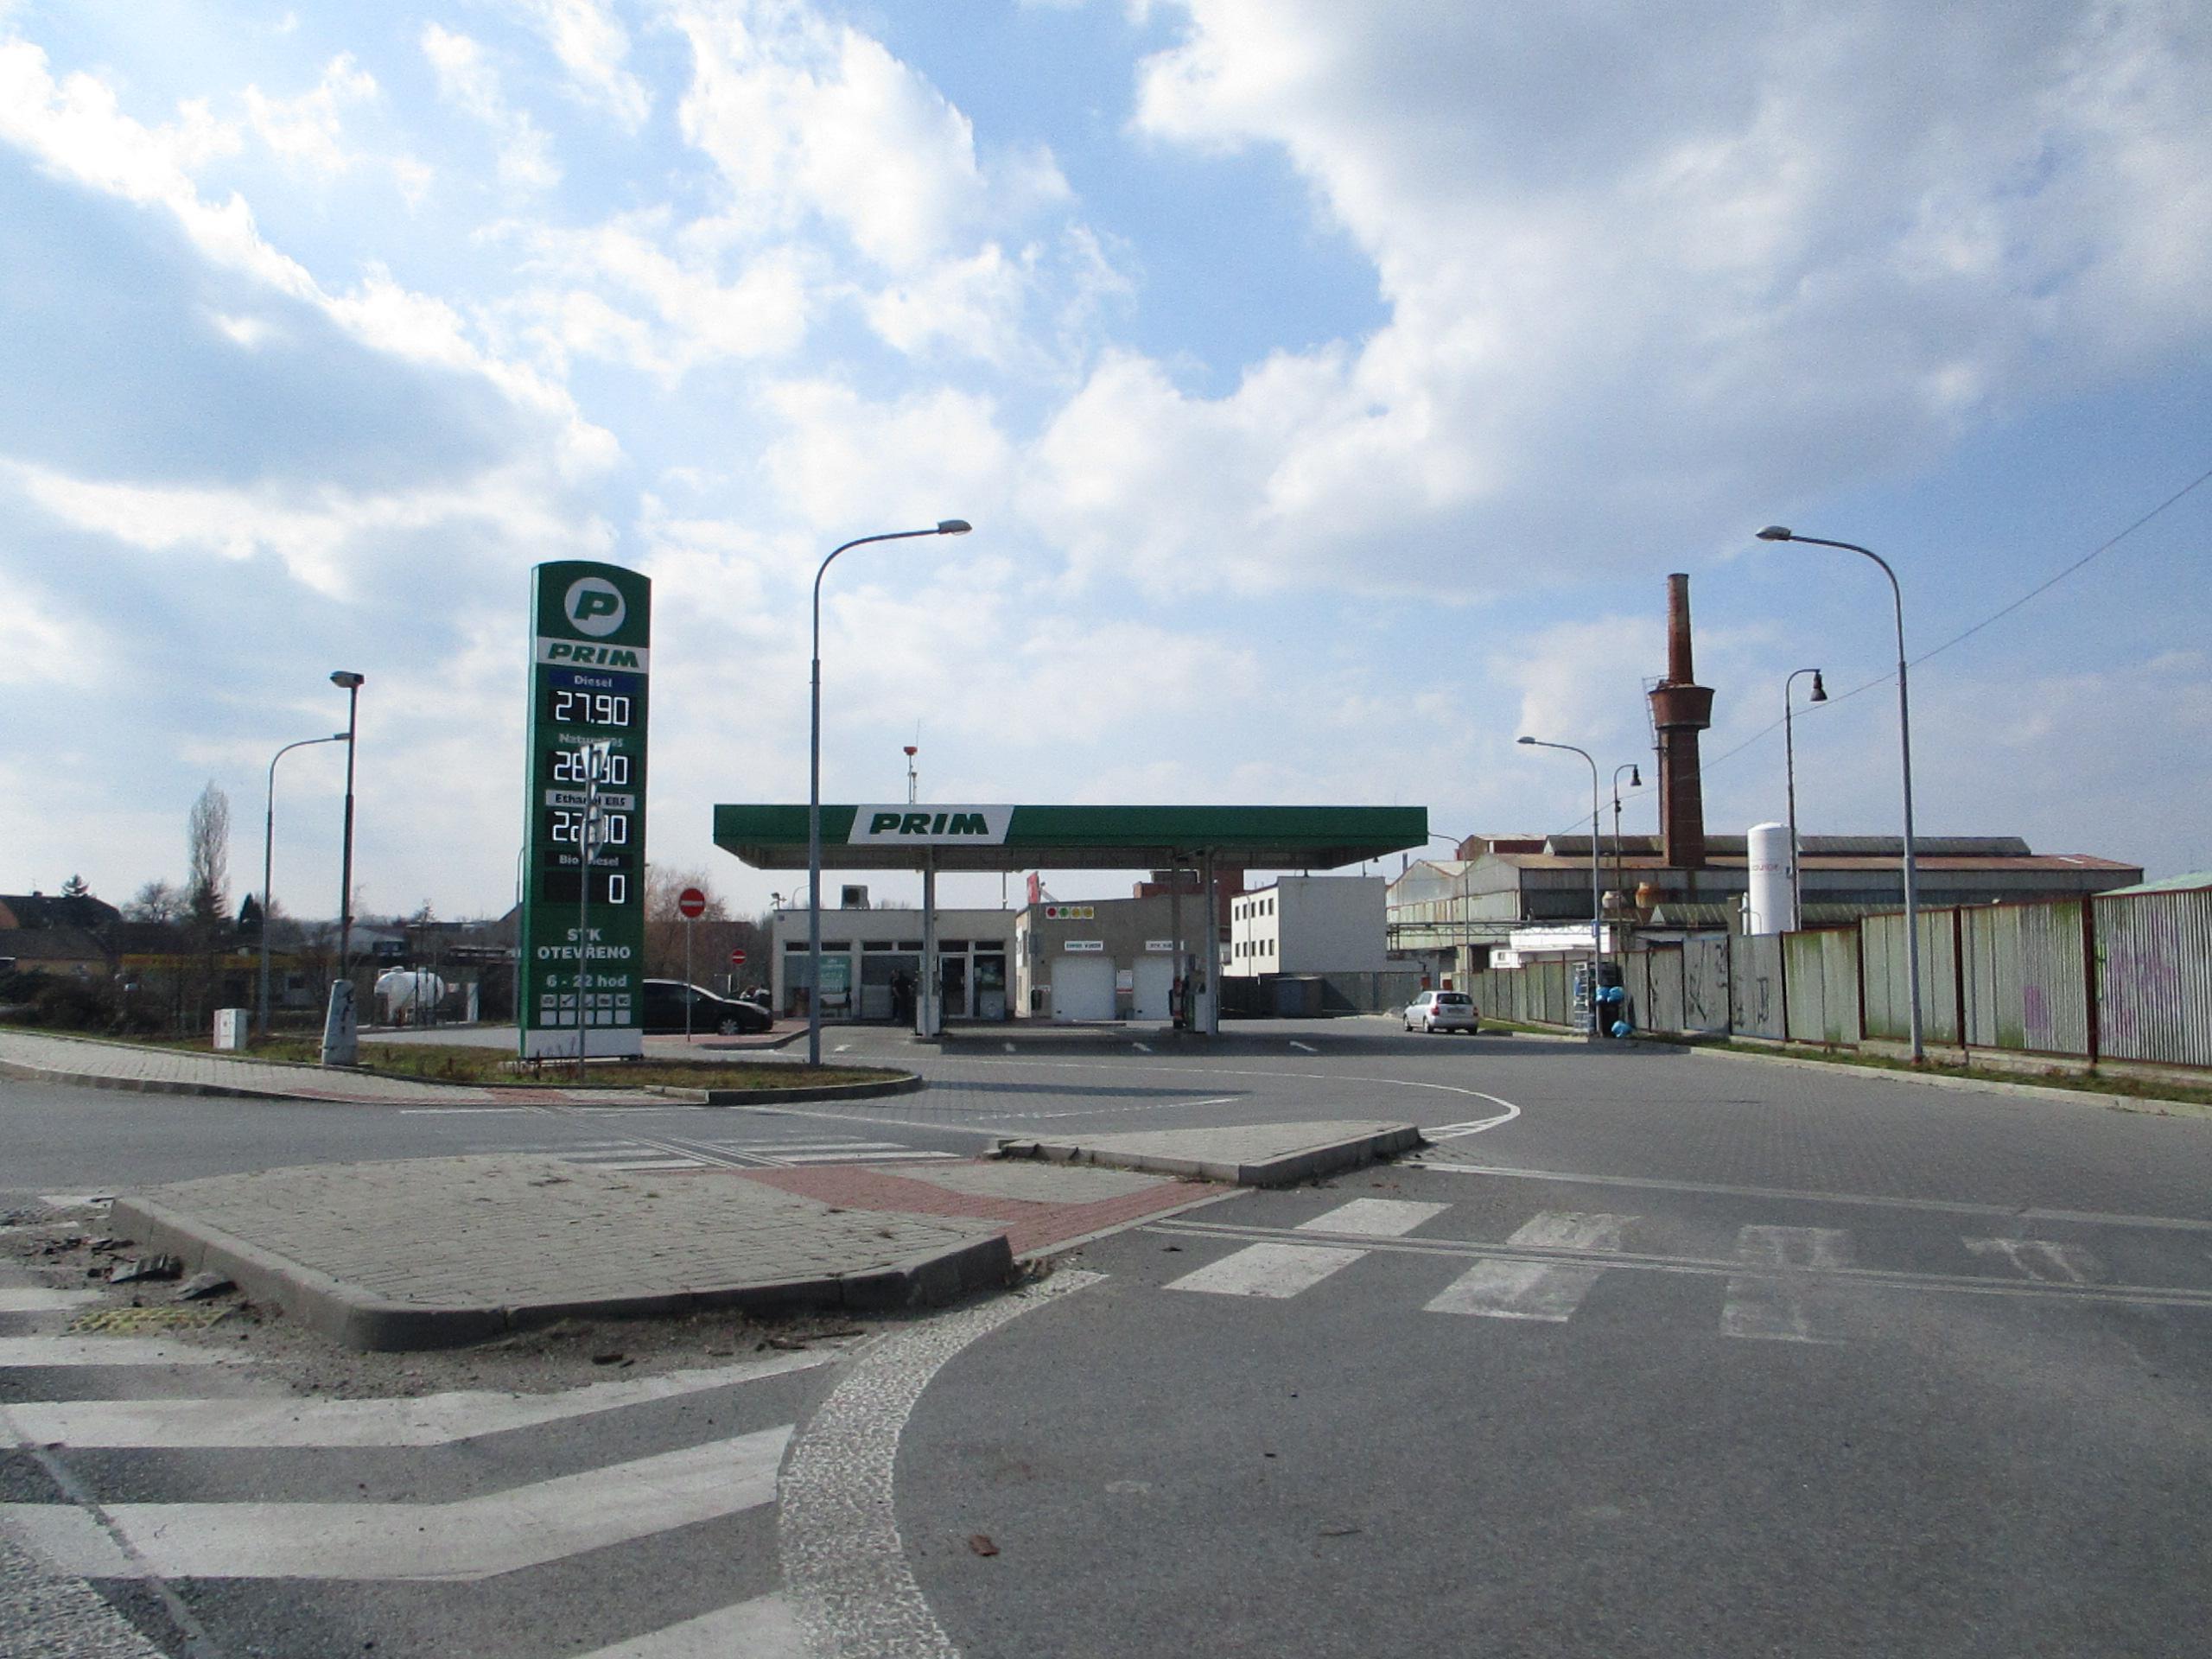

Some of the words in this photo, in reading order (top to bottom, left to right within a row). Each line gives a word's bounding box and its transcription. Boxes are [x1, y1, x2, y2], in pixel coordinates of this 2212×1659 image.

[573, 590, 620, 620] P
[548, 643, 639, 669] PRIM
[574, 675, 613, 689] Diesel
[555, 691, 630, 726] 27.90
[555, 793, 601, 805] Ethal
[869, 813, 990, 835] PRIM
[559, 854, 580, 865] Bio
[586, 855, 620, 867] iesel
[567, 928, 602, 941] SK
[537, 943, 632, 960] OTEVŘENO
[546, 975, 558, 988] 6
[597, 974, 628, 987] hod
